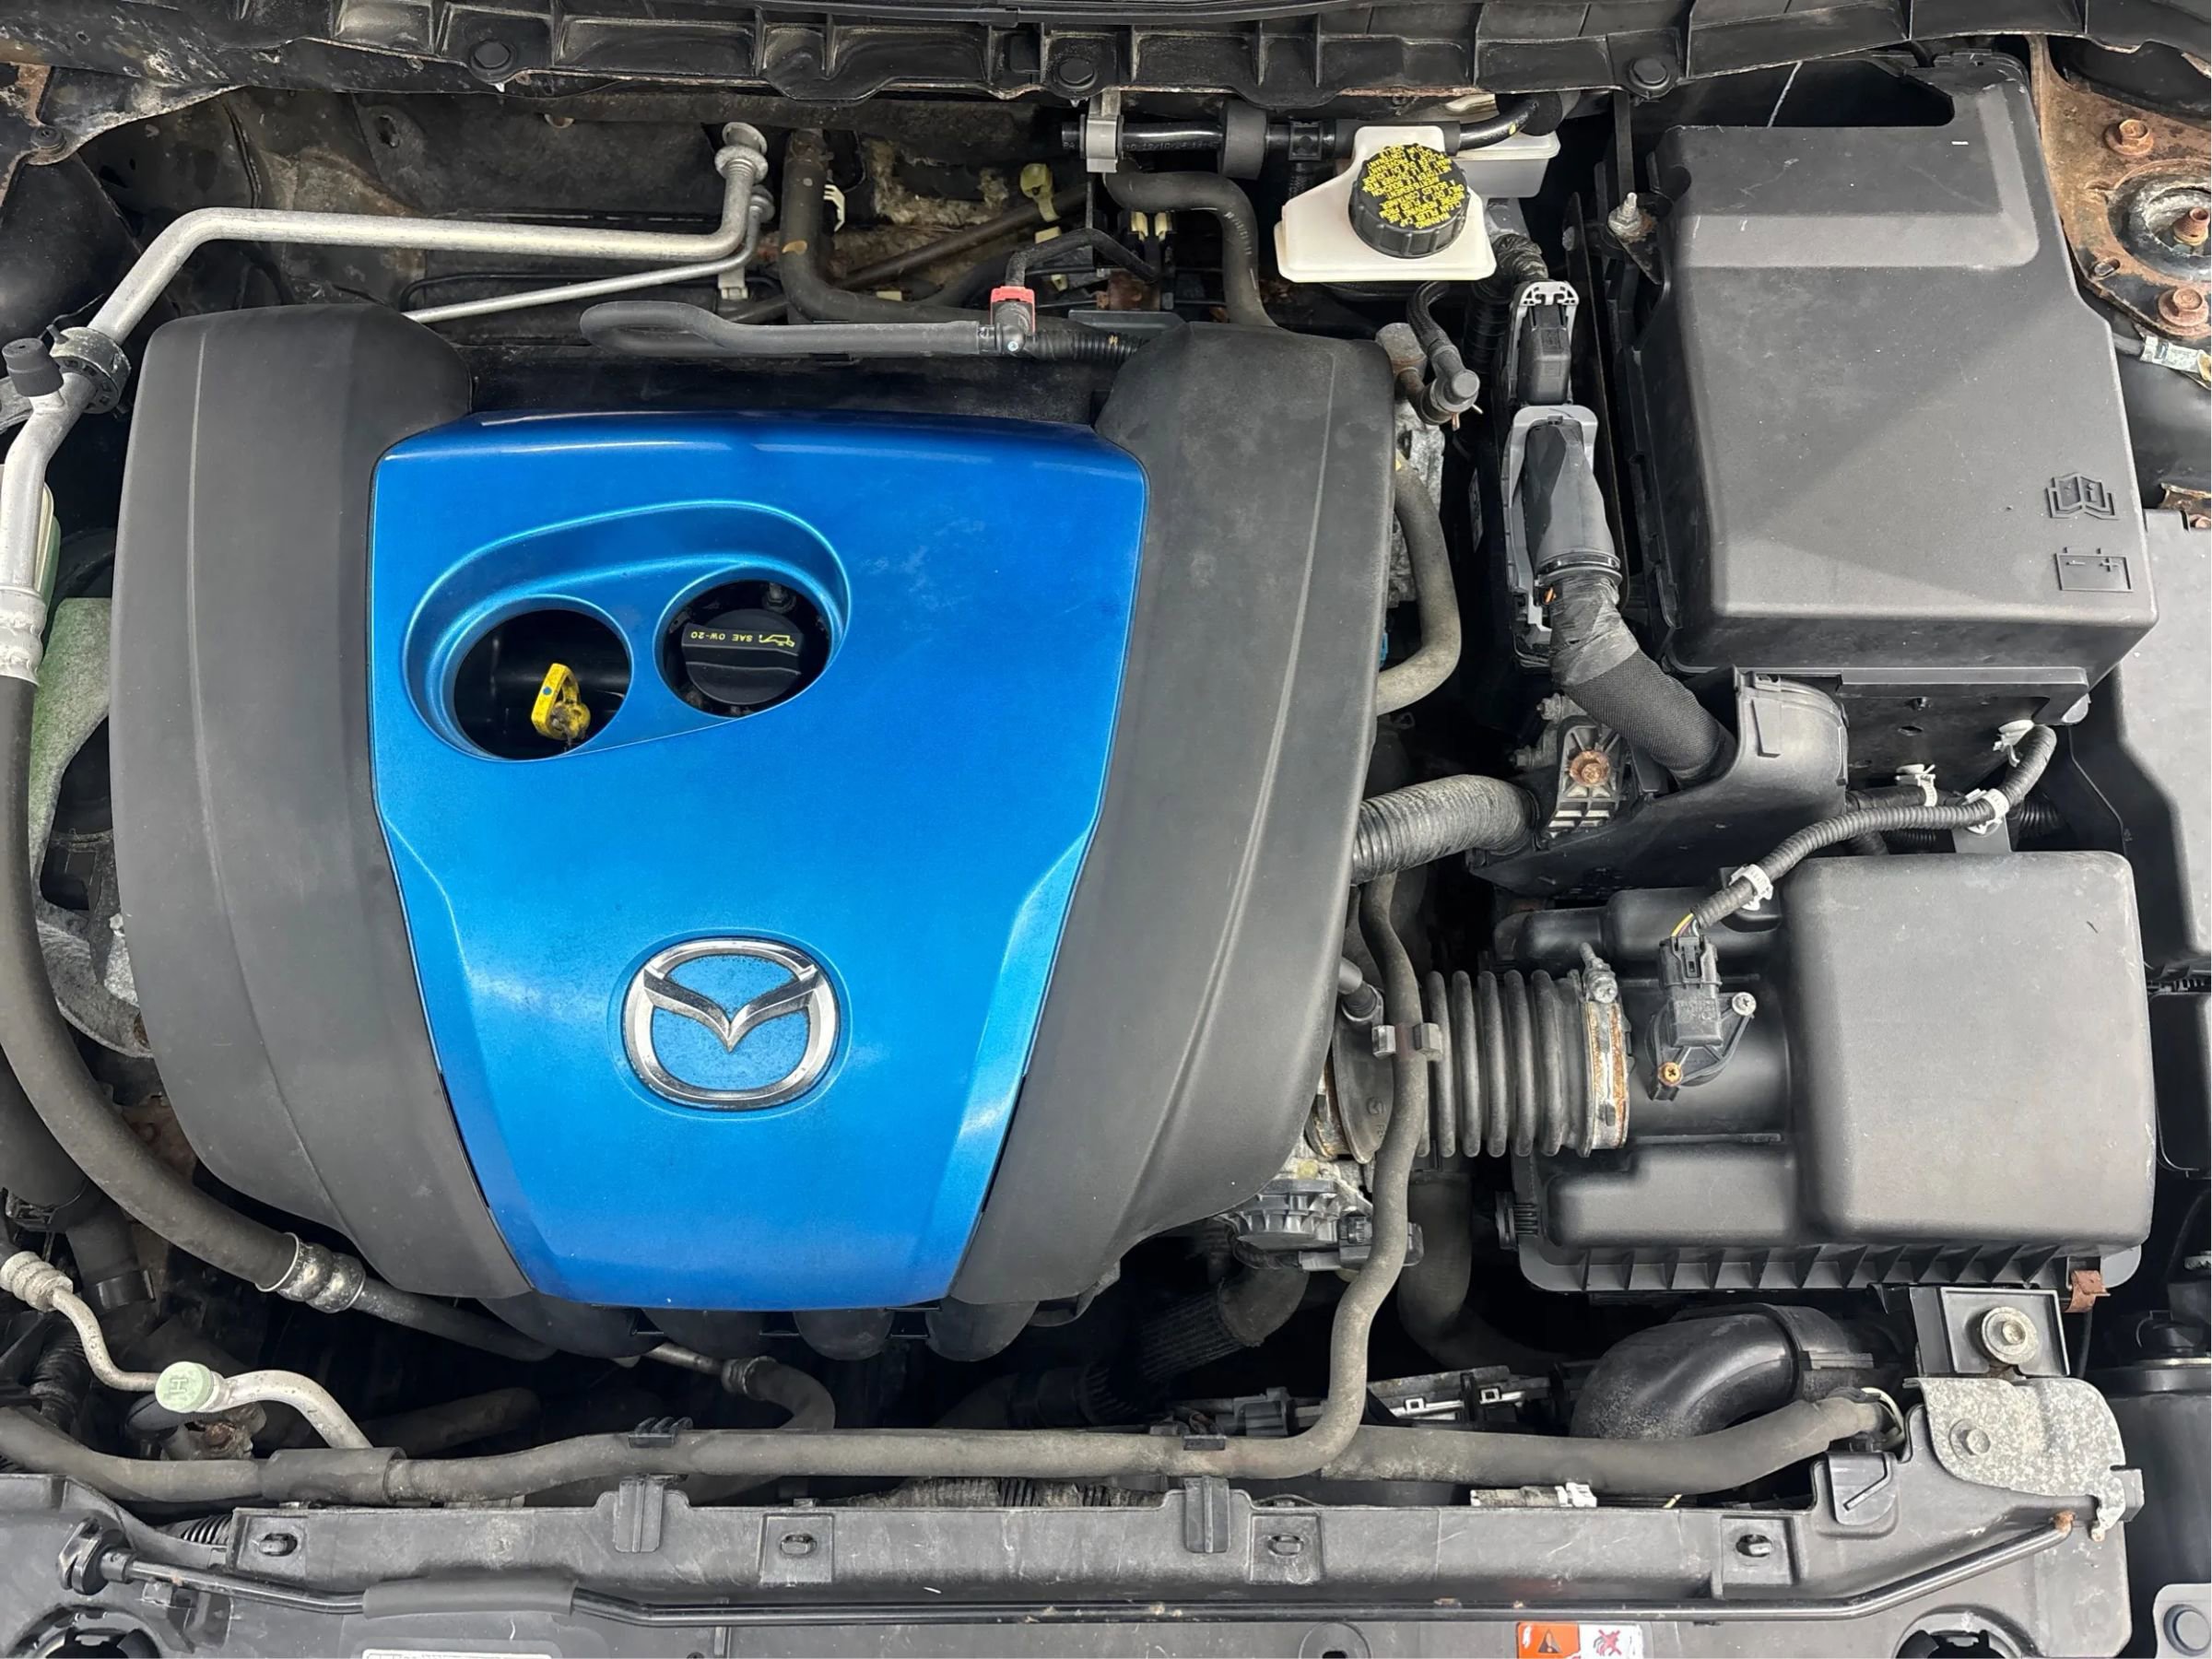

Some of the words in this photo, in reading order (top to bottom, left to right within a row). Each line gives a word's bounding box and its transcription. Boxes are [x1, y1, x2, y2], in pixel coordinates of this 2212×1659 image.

[1365, 150, 1406, 169] CONTENANT
[1367, 156, 1408, 175] PROVENANT
[1361, 170, 1390, 184] LIQUIDE
[1415, 164, 1451, 181] NETTOYER
[1370, 181, 1403, 196] BOUCHON
[1420, 181, 1448, 194] SEALED
[1447, 183, 1465, 194] ONLY
[1399, 197, 1420, 210] FLUID
[1439, 191, 1465, 205] BEFORE
[1378, 206, 1400, 218] FROM
[1439, 200, 1462, 212] CLEAN
[1414, 207, 1439, 221] FILLER
[690, 631, 726, 641] 0W-20
[732, 634, 753, 642] SAE
